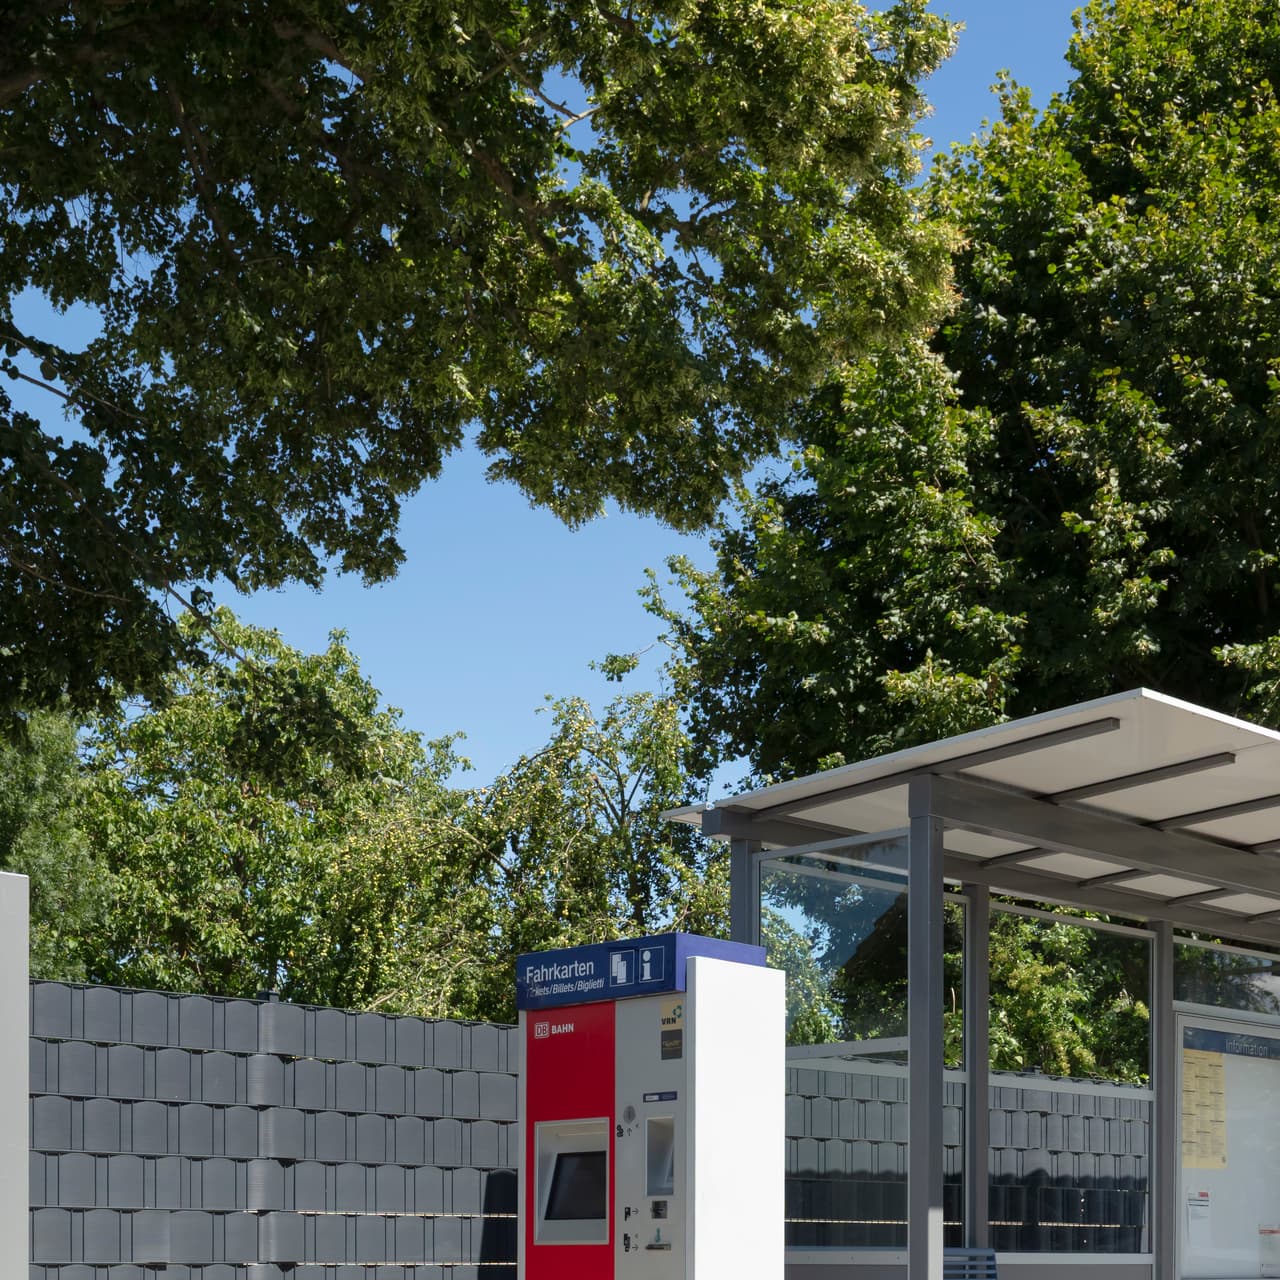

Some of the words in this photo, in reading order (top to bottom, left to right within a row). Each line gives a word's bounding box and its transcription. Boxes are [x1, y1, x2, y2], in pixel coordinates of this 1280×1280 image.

[526, 961, 594, 984] Fahrkarten
[535, 1023, 548, 1037] DB
[551, 1024, 575, 1035] BAHN
[1225, 1040, 1268, 1057] Information
